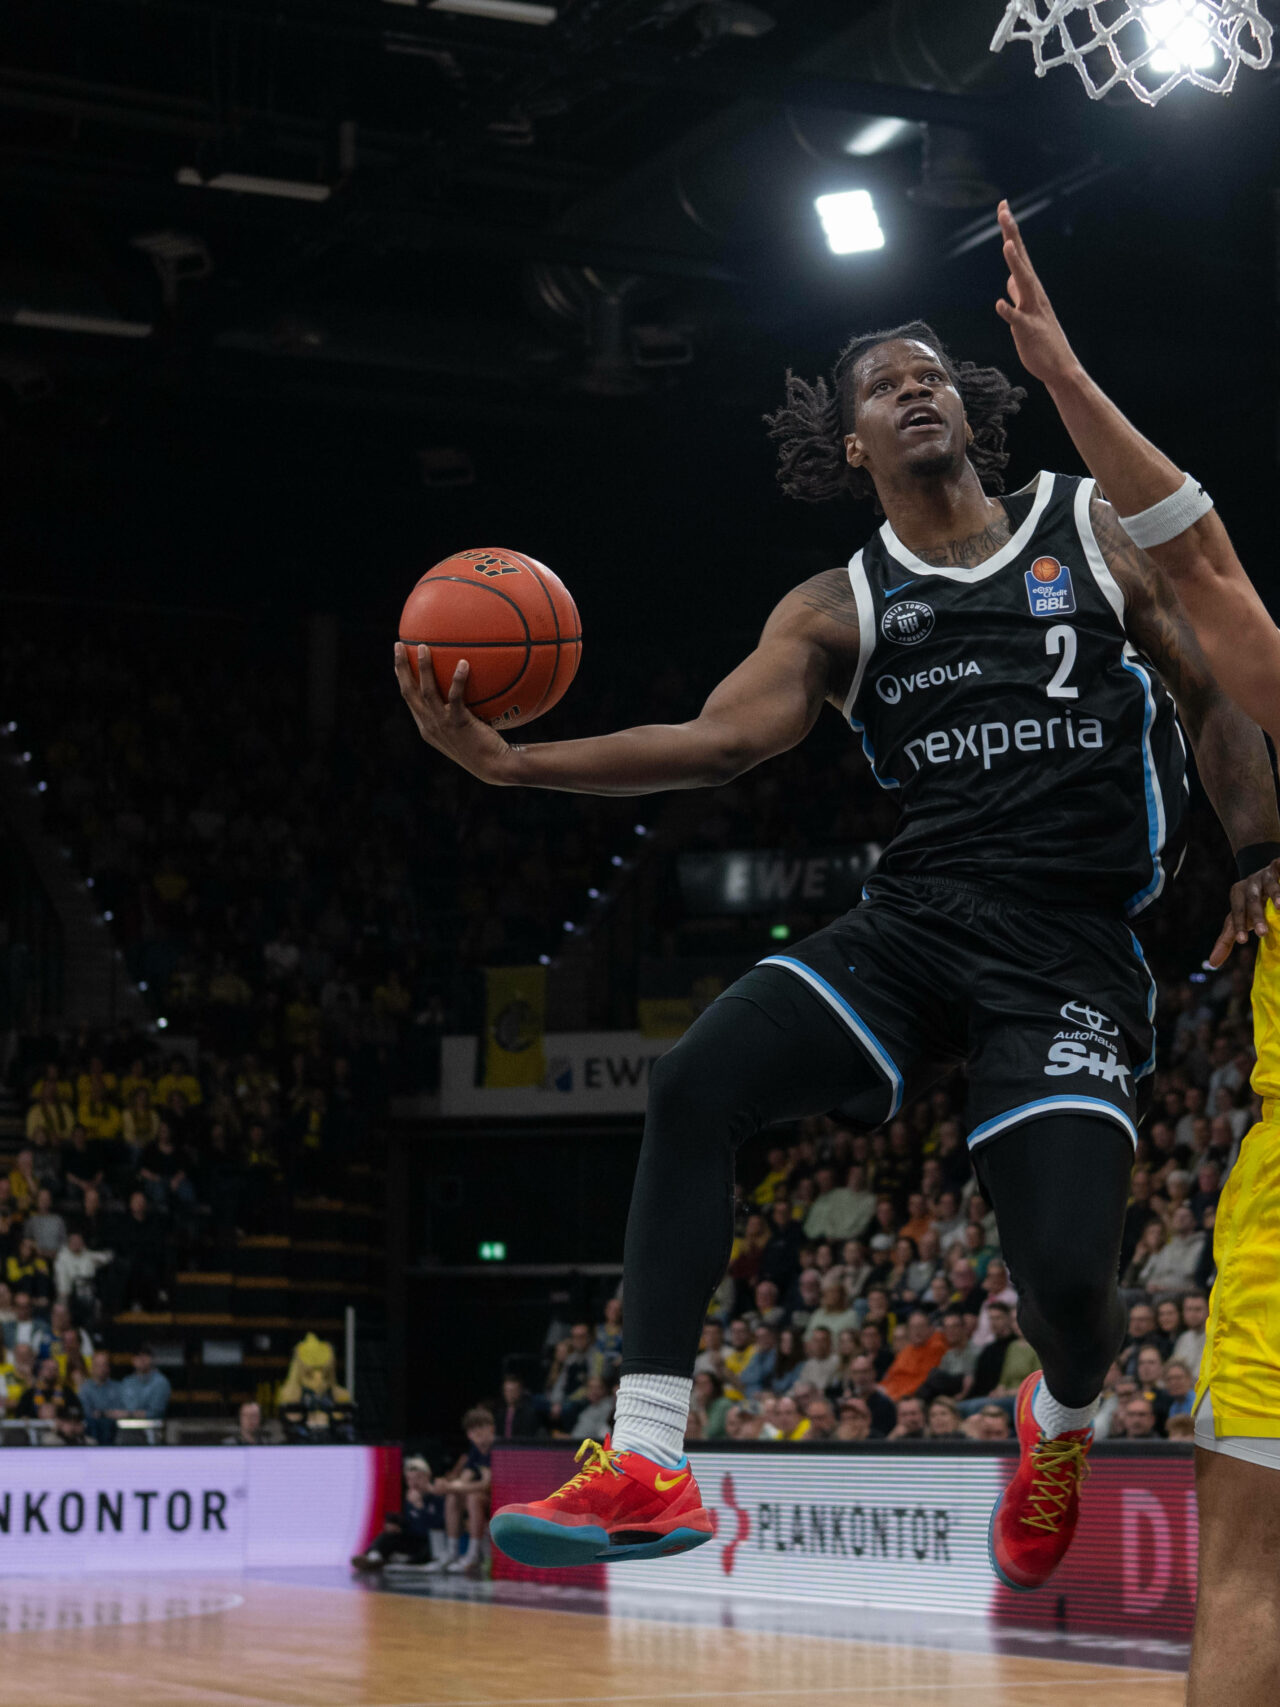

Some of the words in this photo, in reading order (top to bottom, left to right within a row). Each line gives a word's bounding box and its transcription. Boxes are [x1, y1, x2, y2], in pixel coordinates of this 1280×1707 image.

[1036, 597, 1069, 611] BBL
[900, 660, 982, 693] VEOLIA
[1045, 625, 1079, 698] 2
[904, 709, 1103, 771] nexperia
[1053, 1030, 1118, 1054] Autohaus
[758, 1503, 951, 1562] PLANKONTOR
